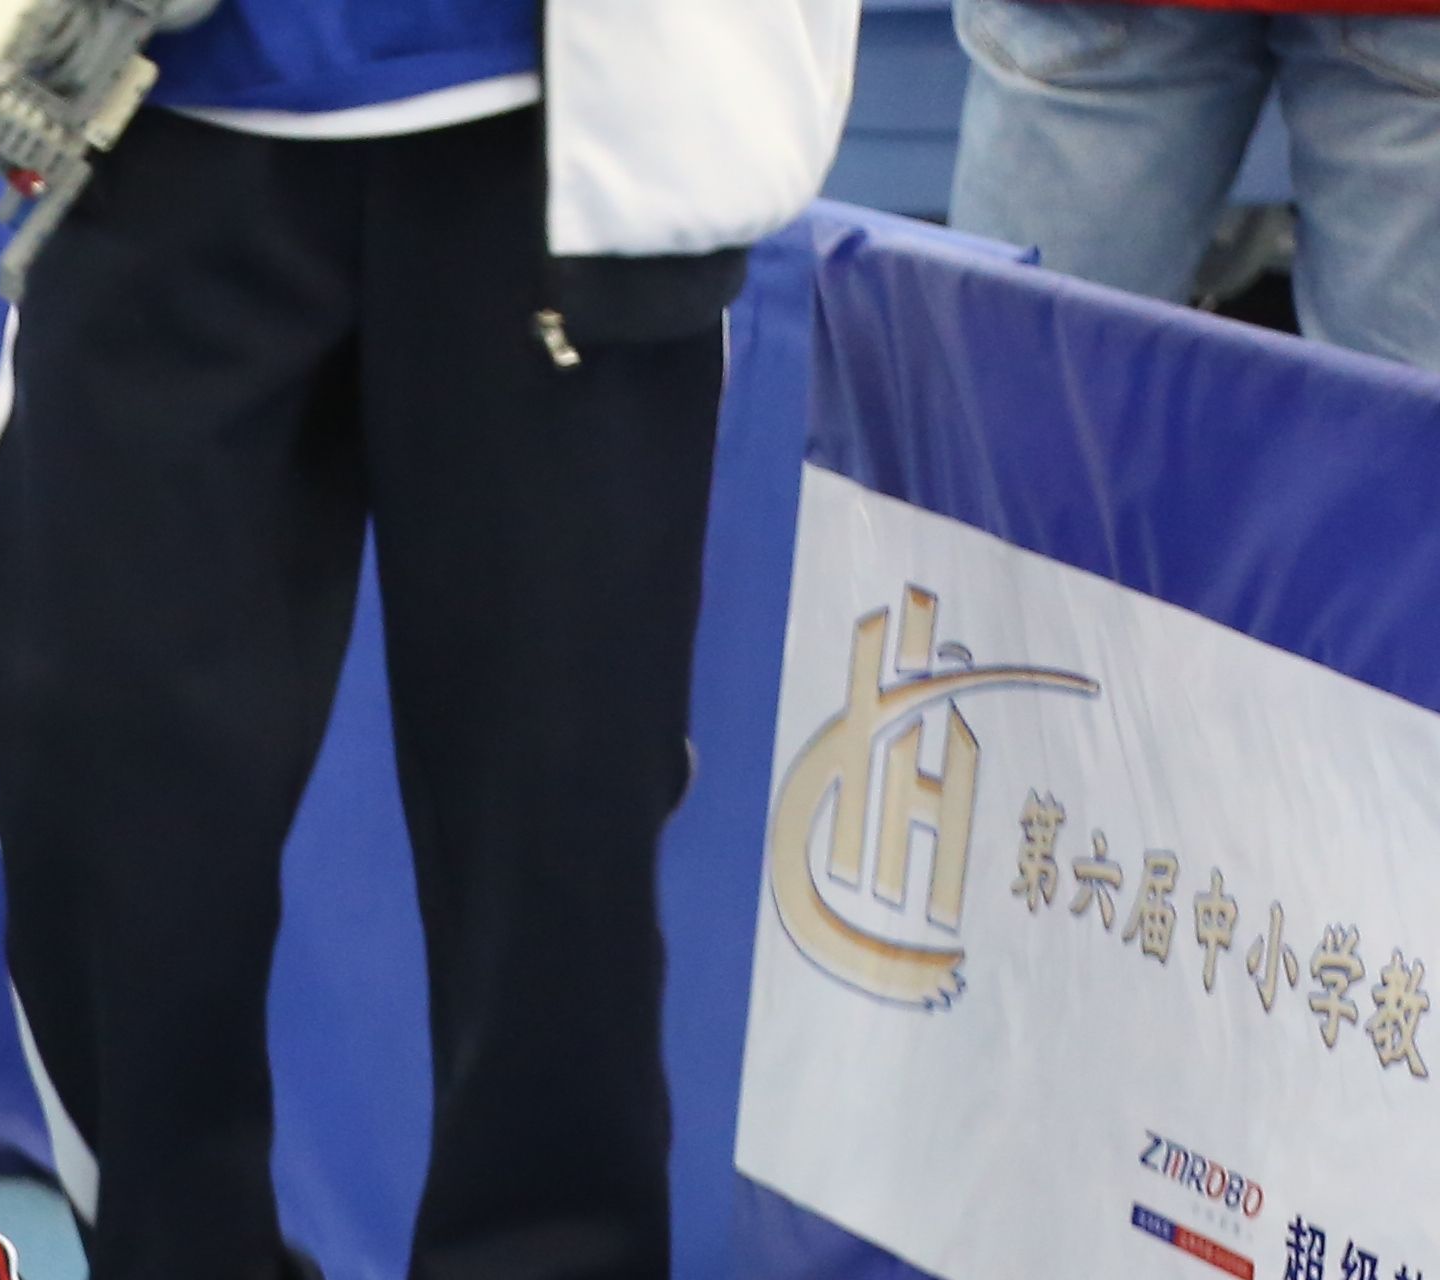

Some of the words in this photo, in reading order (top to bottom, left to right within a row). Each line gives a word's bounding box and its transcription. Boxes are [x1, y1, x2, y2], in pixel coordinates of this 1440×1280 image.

[1010, 786, 1431, 1079] 第六届中小学教
